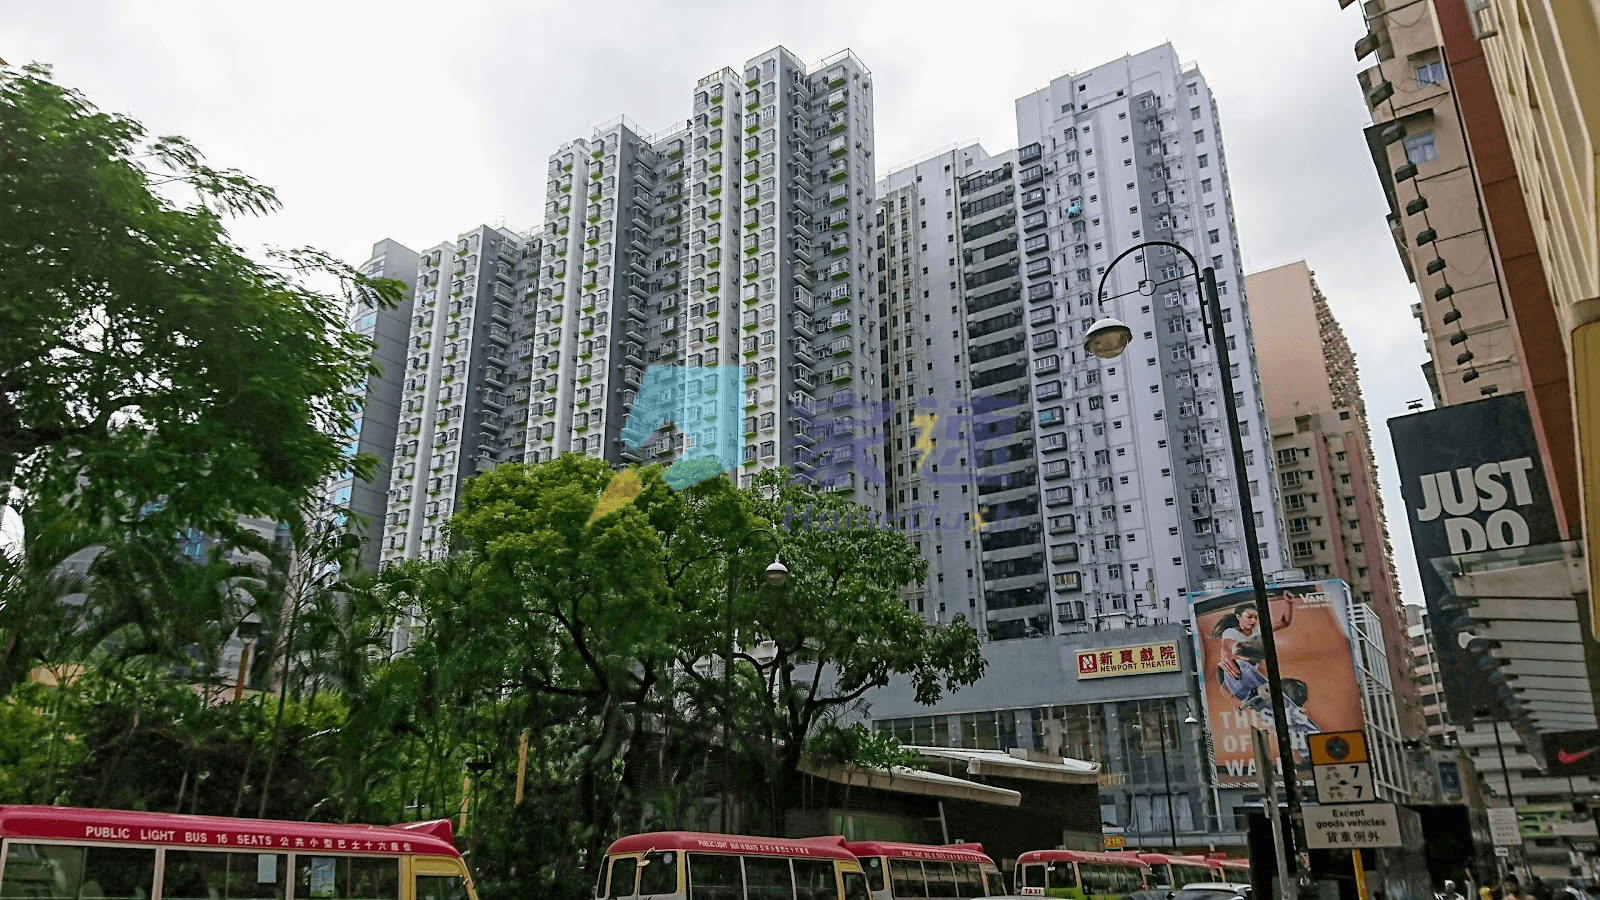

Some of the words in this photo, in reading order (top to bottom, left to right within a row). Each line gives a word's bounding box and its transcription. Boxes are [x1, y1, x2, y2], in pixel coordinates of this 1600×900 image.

[1416, 457, 1533, 522] JUST
[1444, 509, 1530, 555] DO
[1299, 592, 1331, 604] VANS
[1100, 663, 1137, 672] NEWPORT
[1141, 660, 1176, 669] THEATRE
[1218, 708, 1275, 729] THIS
[1350, 766, 1359, 778] 7
[1353, 786, 1362, 798] 7
[1332, 808, 1365, 818] Except
[1316, 821, 1344, 830] goods
[1347, 818, 1386, 827] vehicles
[86, 826, 130, 839] PUBLIC
[140, 829, 175, 842] LIGHT
[185, 831, 207, 843] BUS
[216, 833, 228, 844] 16
[236, 834, 272, 846] SEATS
[1326, 830, 1380, 843] 貨車例外
